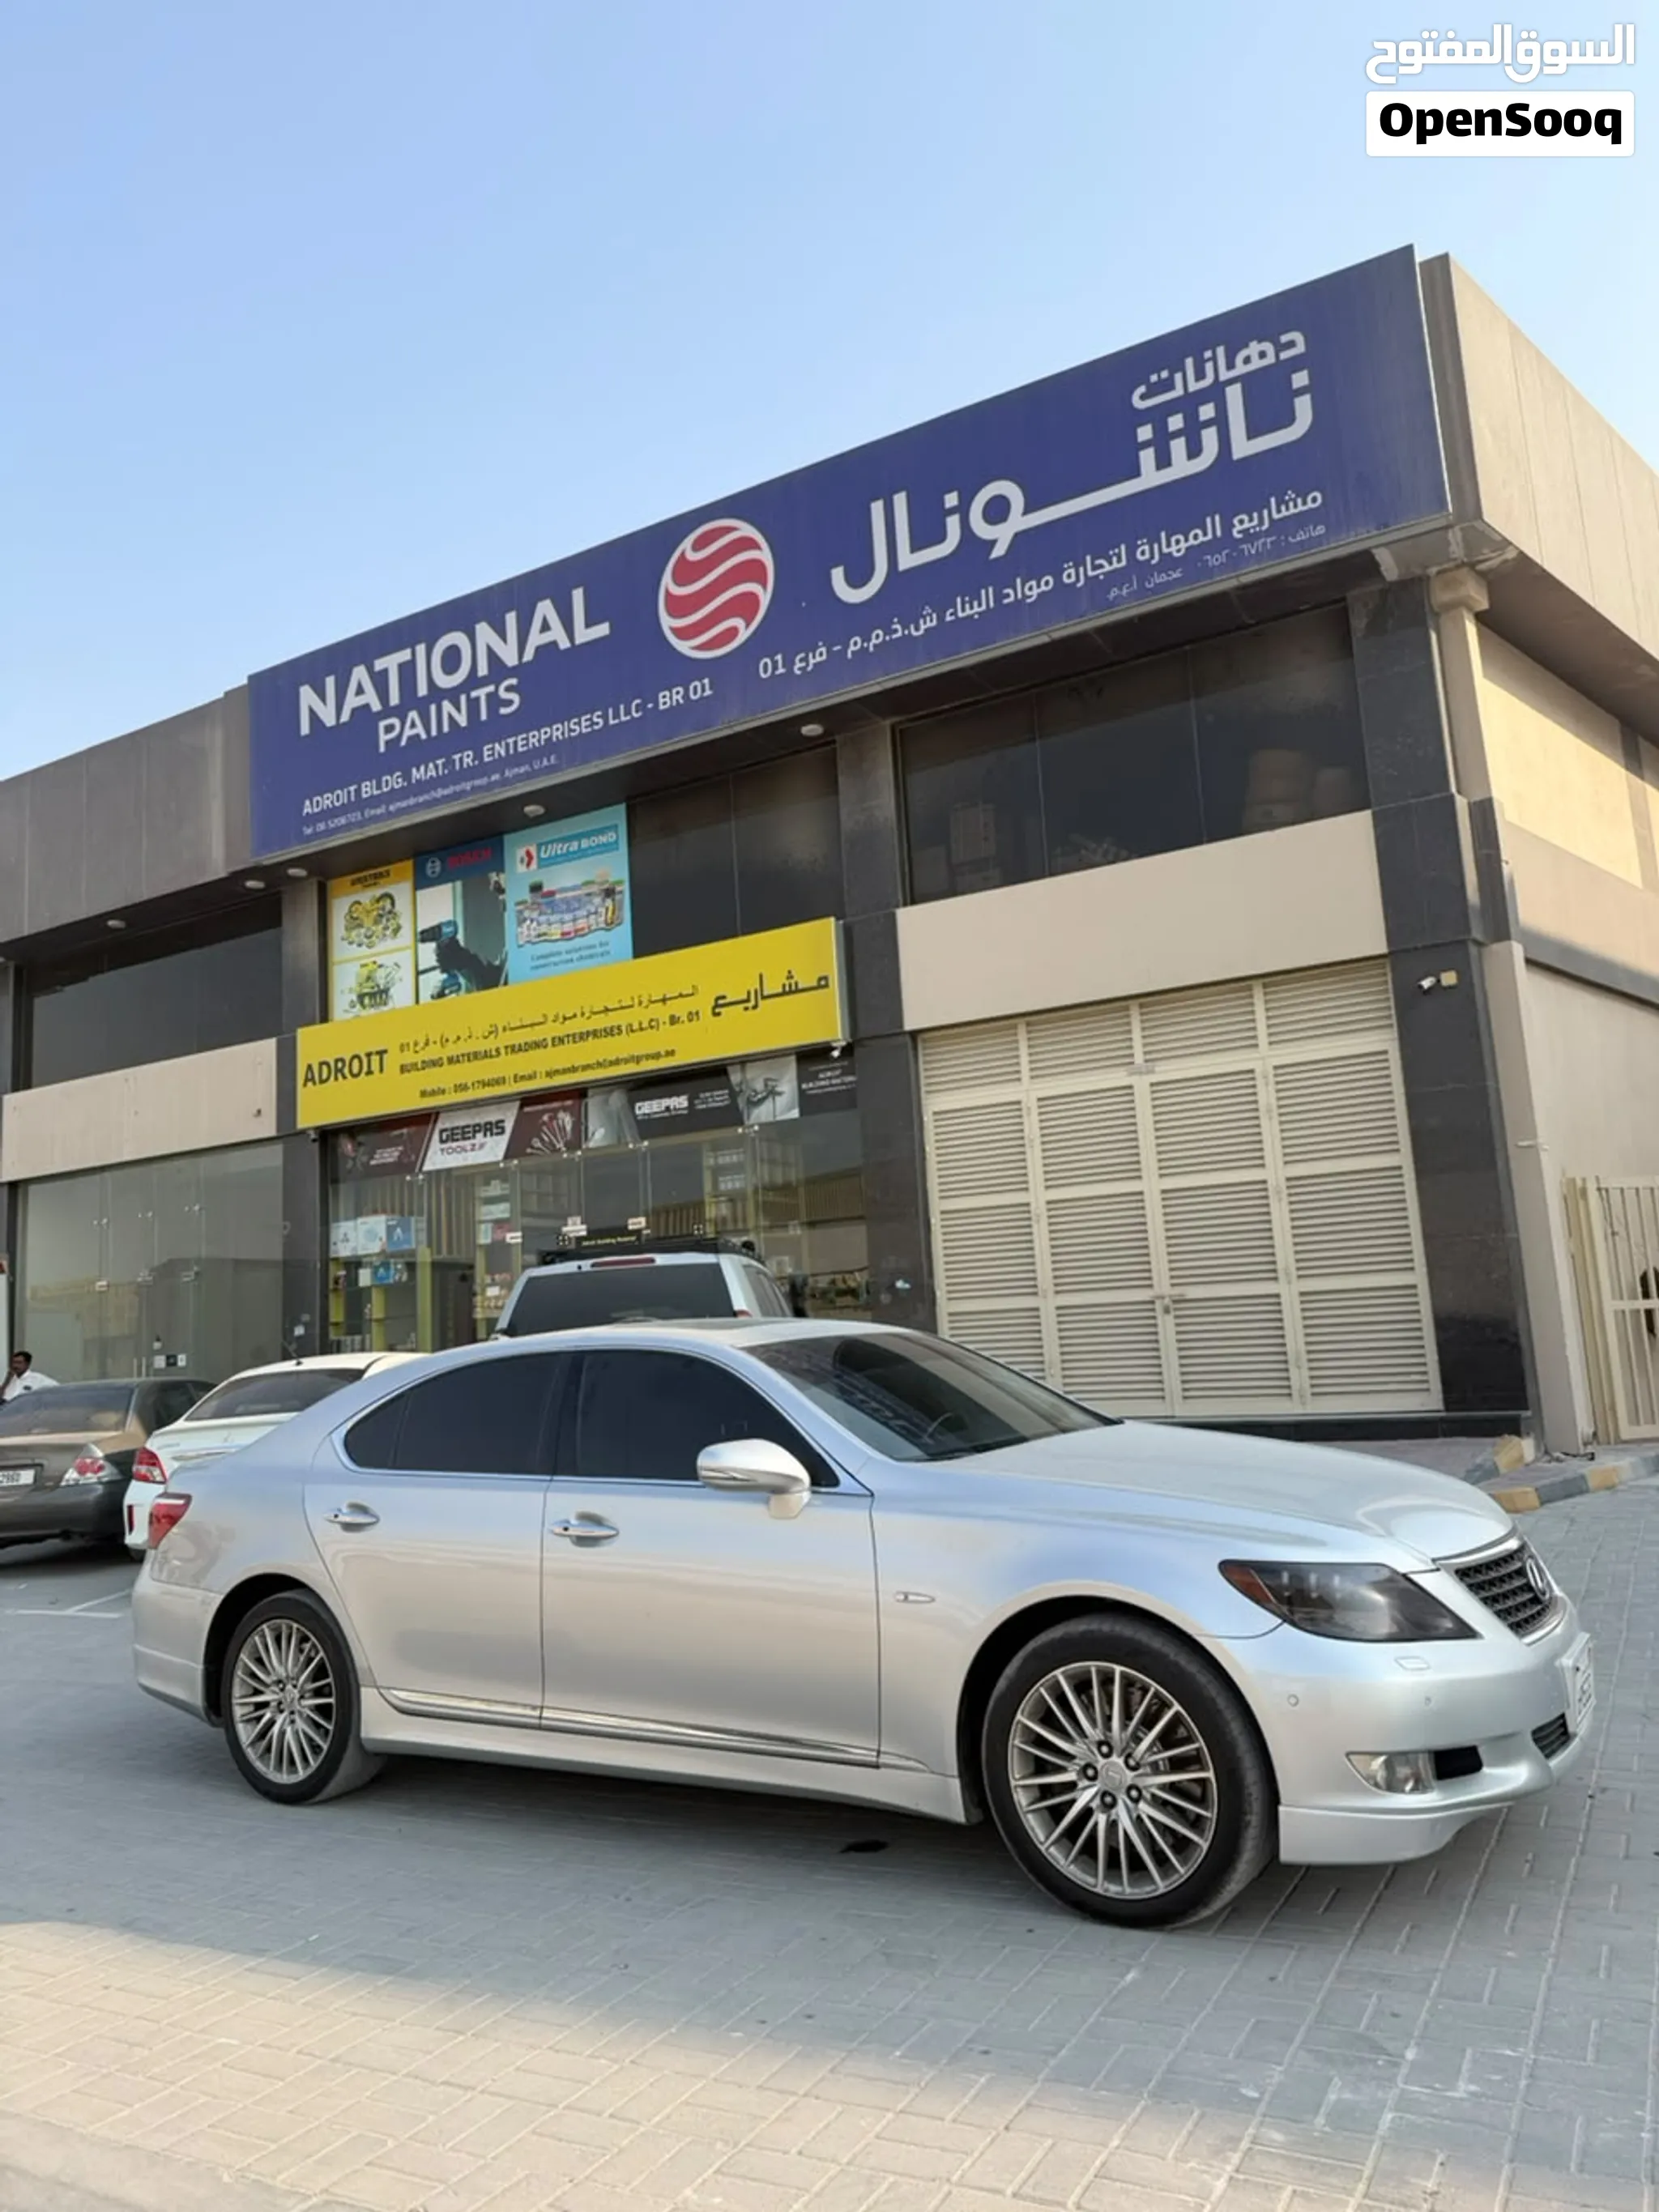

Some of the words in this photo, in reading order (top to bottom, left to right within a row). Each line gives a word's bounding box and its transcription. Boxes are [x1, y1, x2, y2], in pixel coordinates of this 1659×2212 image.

[1131, 330, 1307, 411] دهانات
[830, 369, 1313, 604] ناشونال
[1231, 488, 1323, 539] مشاريع
[1136, 514, 1222, 565] المهارة
[1062, 543, 1127, 588] لتجارة
[1144, 567, 1183, 589] عجمان
[945, 586, 995, 623] البناء
[1001, 574, 1054, 604] مواد
[299, 586, 610, 736] NATIONAL
[758, 654, 787, 679] 01
[793, 641, 828, 676] فرع
[378, 678, 521, 753] PAINTS
[302, 783, 360, 816] ADROIT
[361, 771, 407, 799] BLDG.
[411, 757, 449, 784] MAT.
[451, 749, 480, 772] TR.
[484, 711, 604, 762] ENTERPRISES
[608, 699, 643, 726] LLC
[658, 686, 685, 711] BR
[689, 677, 714, 700] 01
[539, 840, 579, 859] Ultra
[580, 831, 617, 850] BOND
[580, 996, 635, 1021] لتجارة
[638, 984, 699, 1009] المهارة
[710, 969, 830, 1018] مشاريع
[551, 1011, 578, 1025] مواد
[399, 1056, 445, 1076] BUILDING
[447, 1046, 501, 1067] MATERIALS
[504, 1037, 549, 1058] TRADING
[551, 1024, 623, 1048] ENTERPRISES
[669, 1013, 685, 1027] Br.
[687, 1009, 701, 1023] 01
[412, 1033, 430, 1055] فرع
[302, 1048, 388, 1088] ADROIT
[513, 1070, 537, 1084] Email
[634, 1094, 689, 1115] GEEPAS
[439, 1119, 505, 1145] GEEPAS
